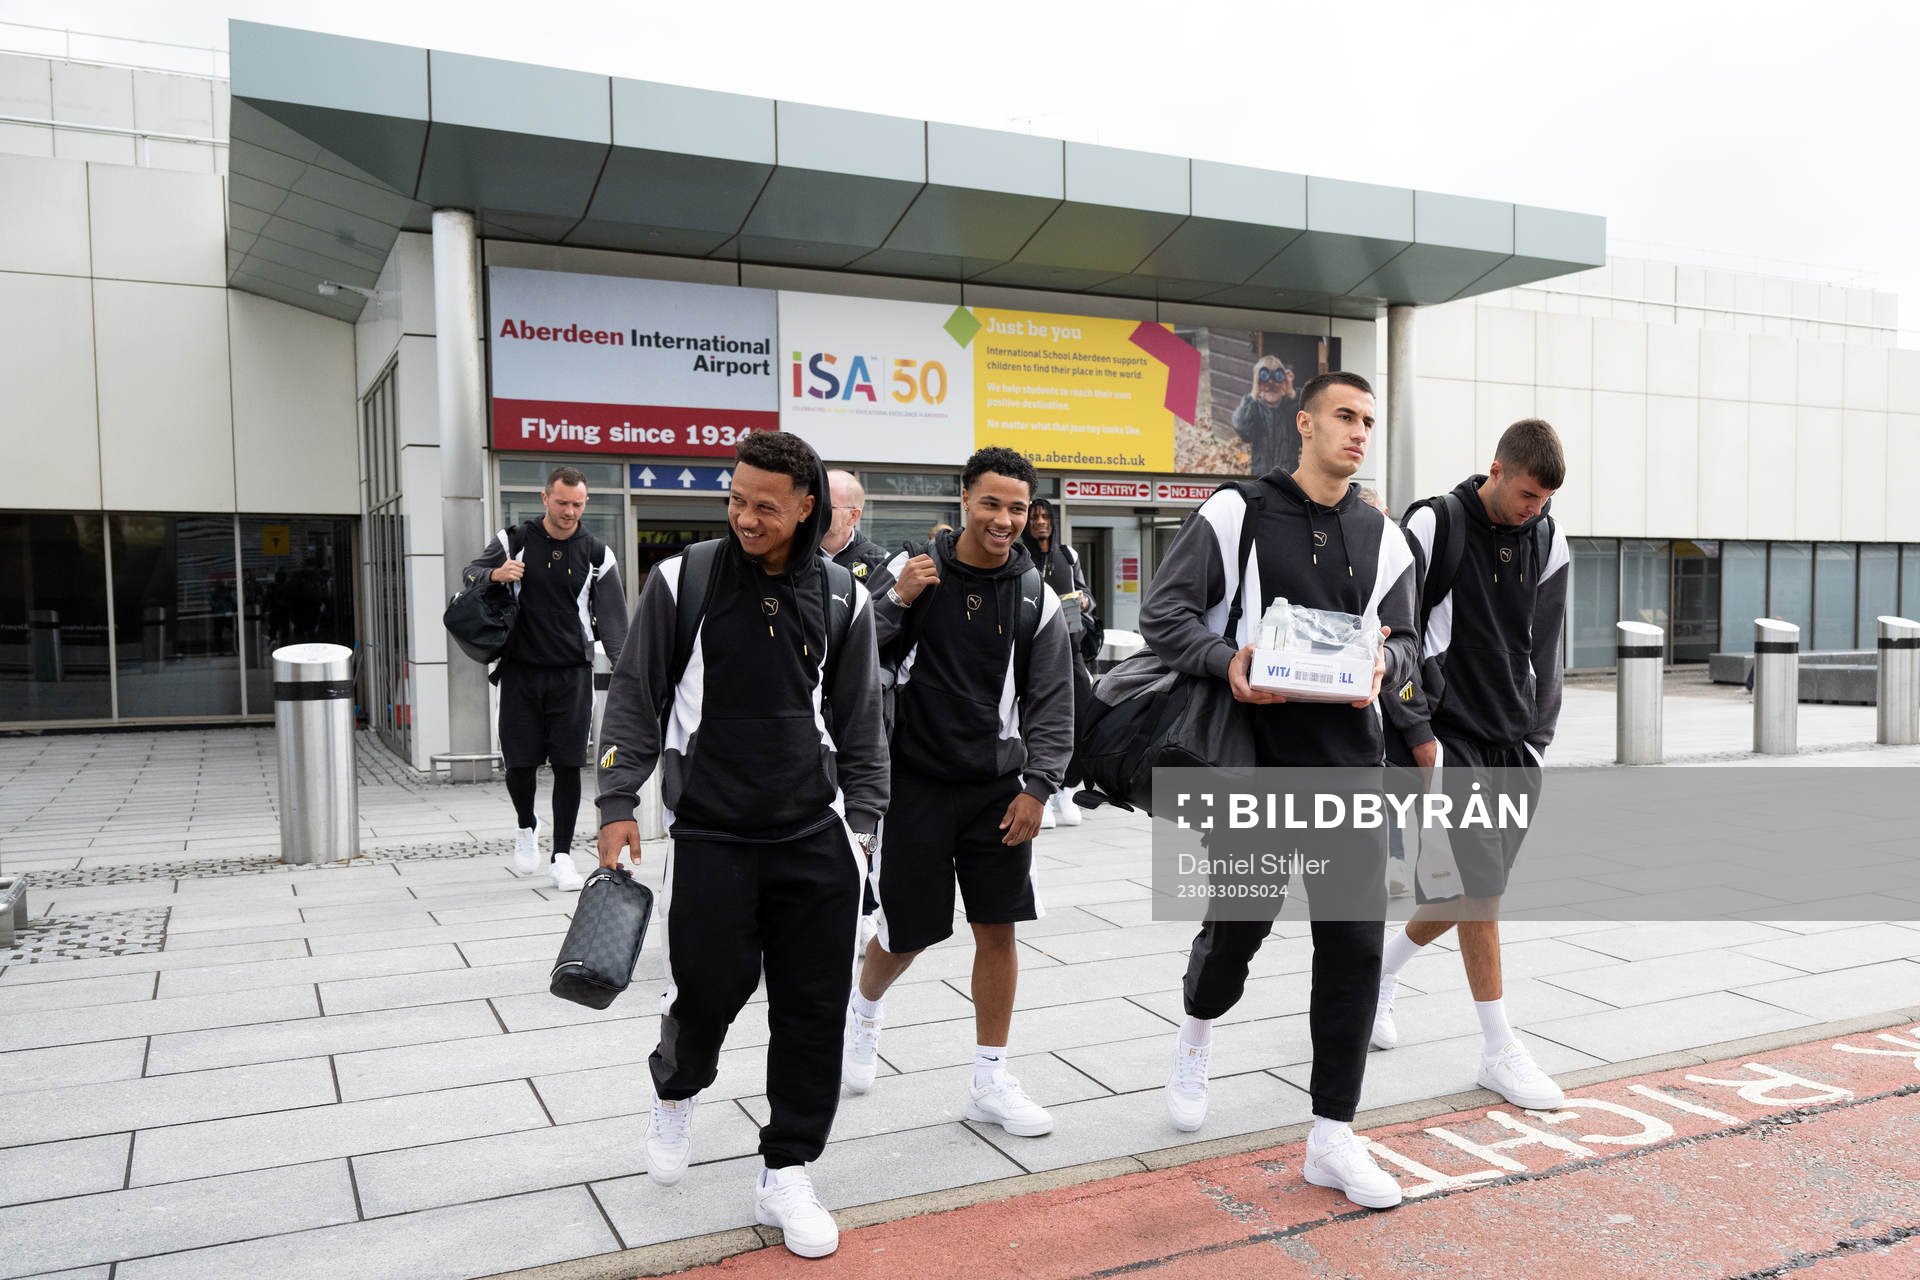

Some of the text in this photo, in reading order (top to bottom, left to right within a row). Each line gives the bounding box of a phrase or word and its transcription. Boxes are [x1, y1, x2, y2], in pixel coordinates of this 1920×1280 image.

[500, 319, 770, 355] Aberdeen International
[986, 318, 1082, 342] Just be you
[693, 355, 770, 377] Airport
[986, 346, 1148, 367] International School Aberdeen supports
[986, 361, 1144, 379] children to find their place in the world.
[891, 359, 948, 405] 50
[1002, 383, 1021, 395] help
[1023, 385, 1059, 395] students
[520, 417, 751, 446] Flying since 1934
[1080, 484, 1135, 496] NO ENTRY
[1171, 487, 1187, 497] NO
[1366, 1062, 1853, 1197] RIGHT
